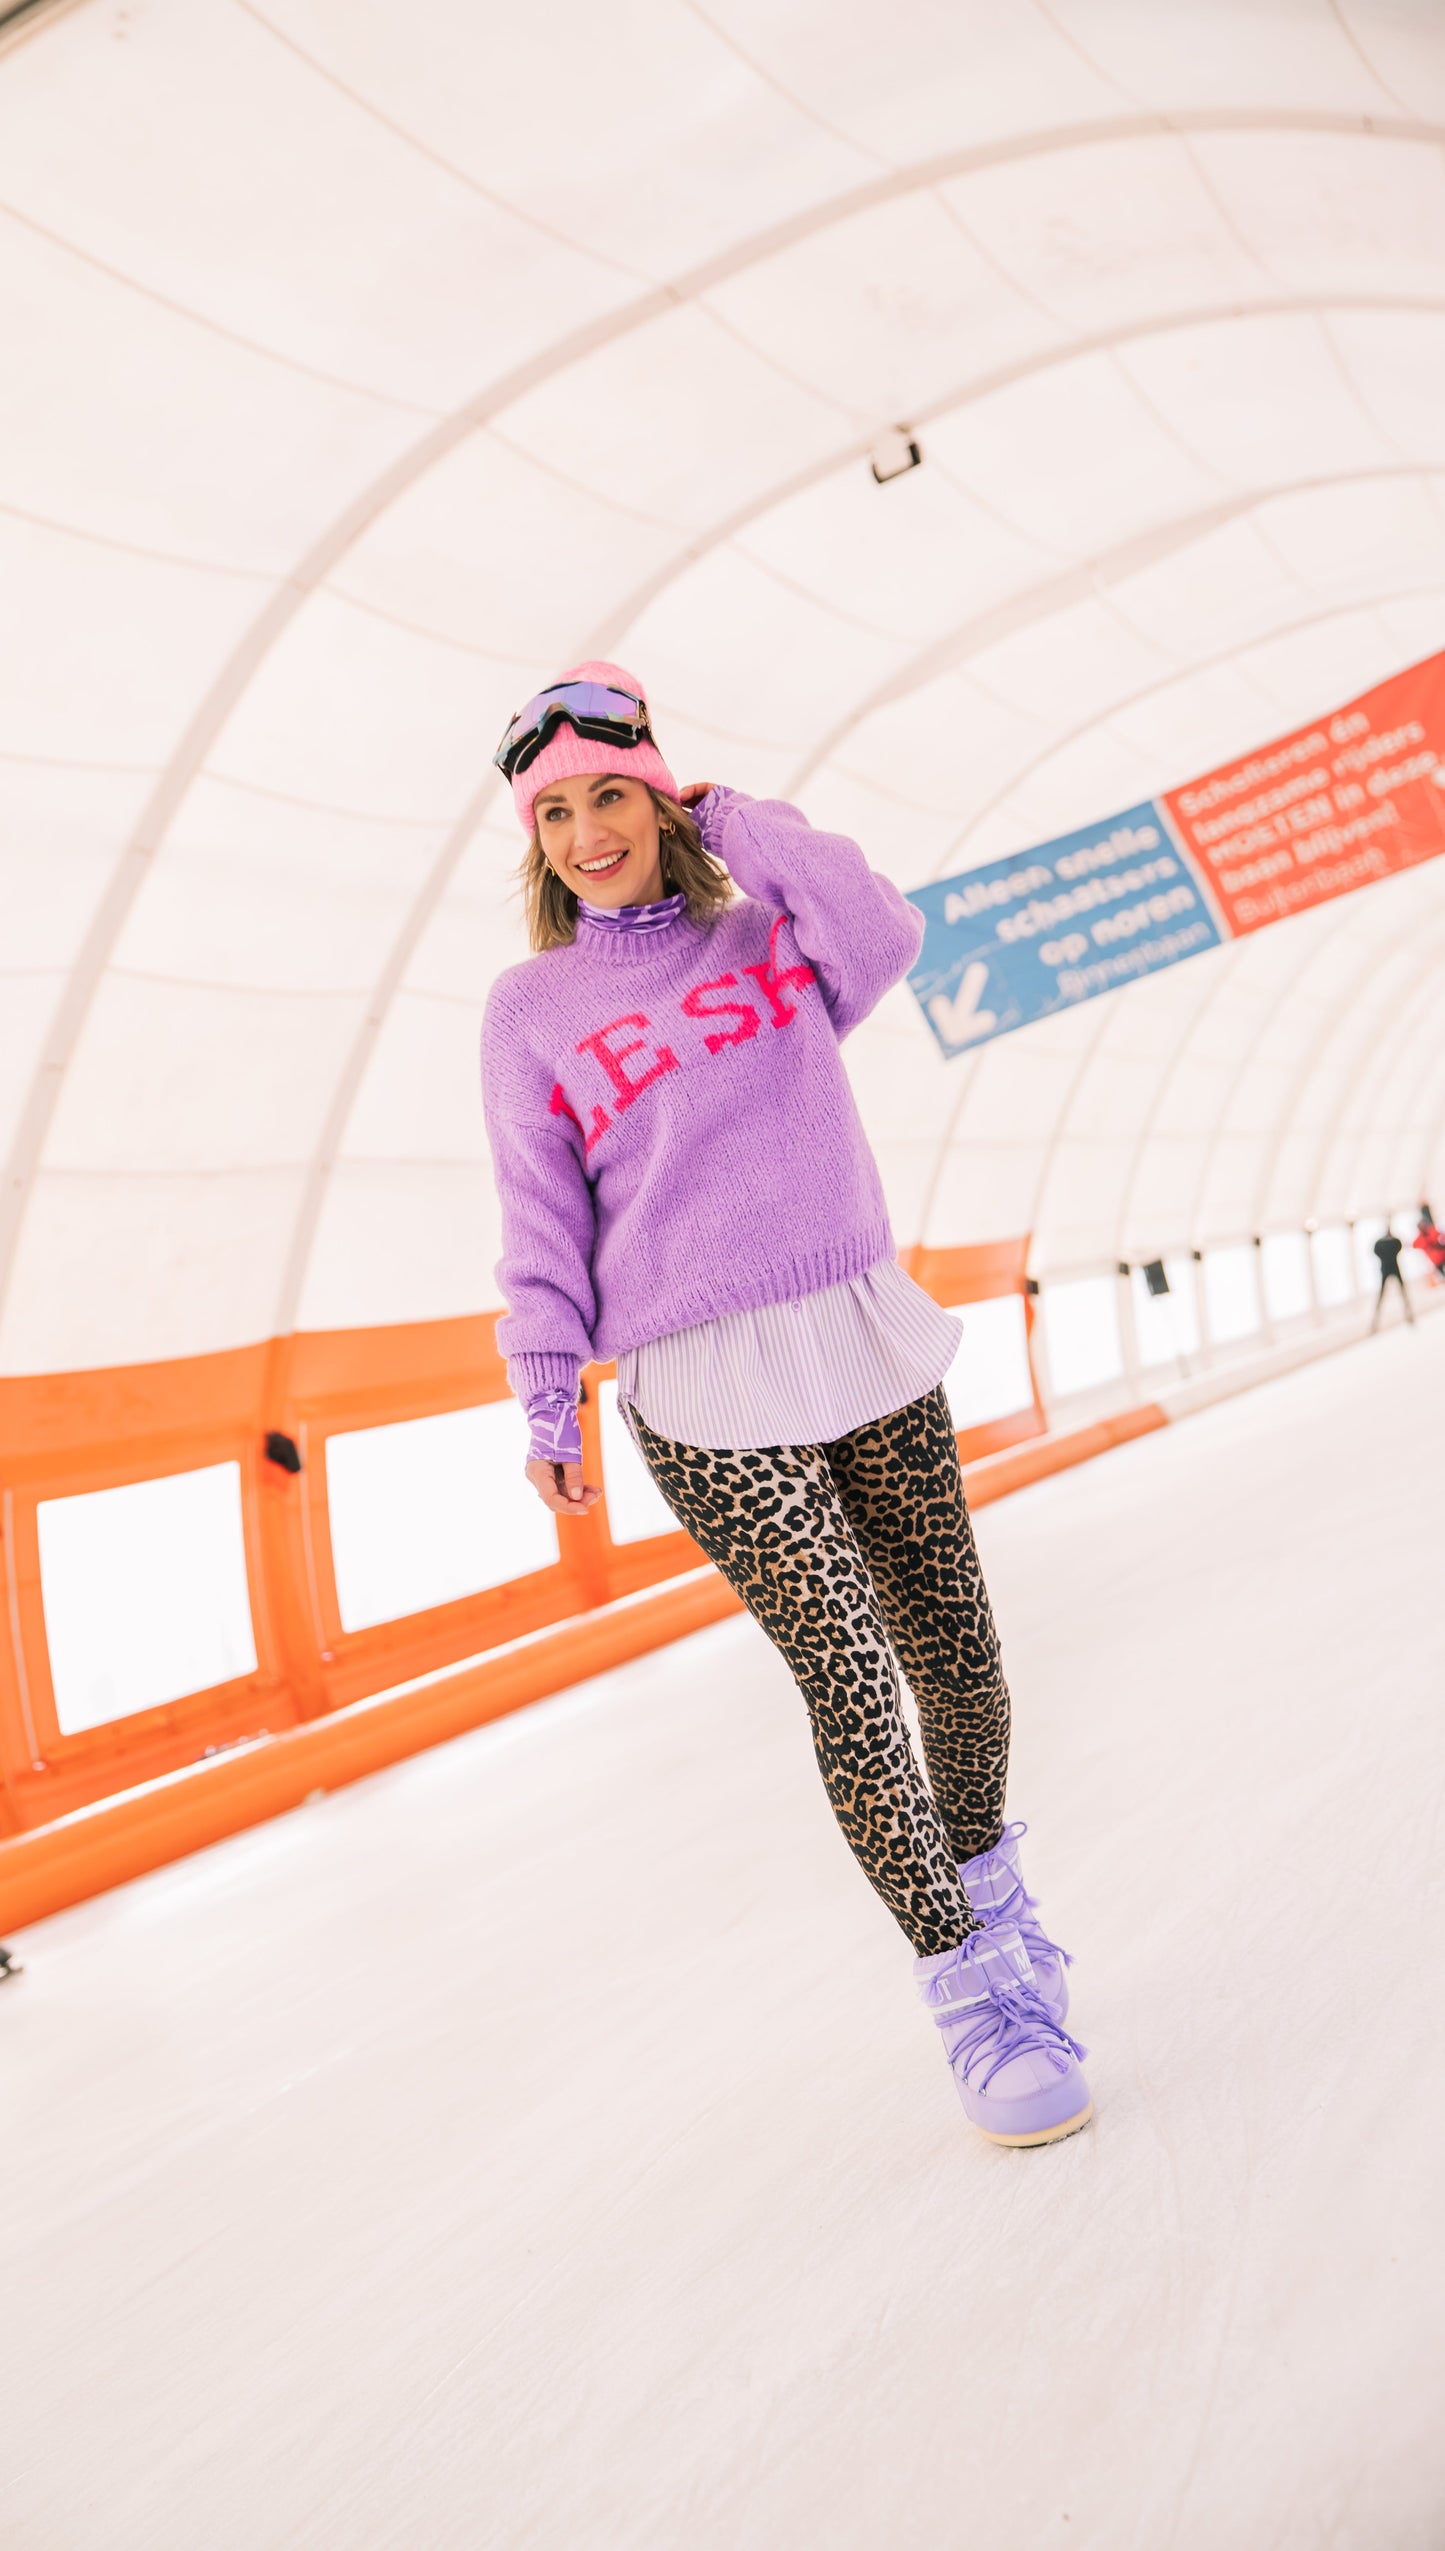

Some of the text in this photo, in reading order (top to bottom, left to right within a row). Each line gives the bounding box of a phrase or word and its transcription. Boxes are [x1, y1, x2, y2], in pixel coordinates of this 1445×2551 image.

[1192, 721, 1425, 845] langzame rijders
[1207, 751, 1438, 867] MOETEN in deze
[944, 826, 1160, 925] Alleen snelle
[996, 856, 1179, 943] schaatsers
[1219, 850, 1293, 894] baan
[1039, 886, 1195, 967] op noren
